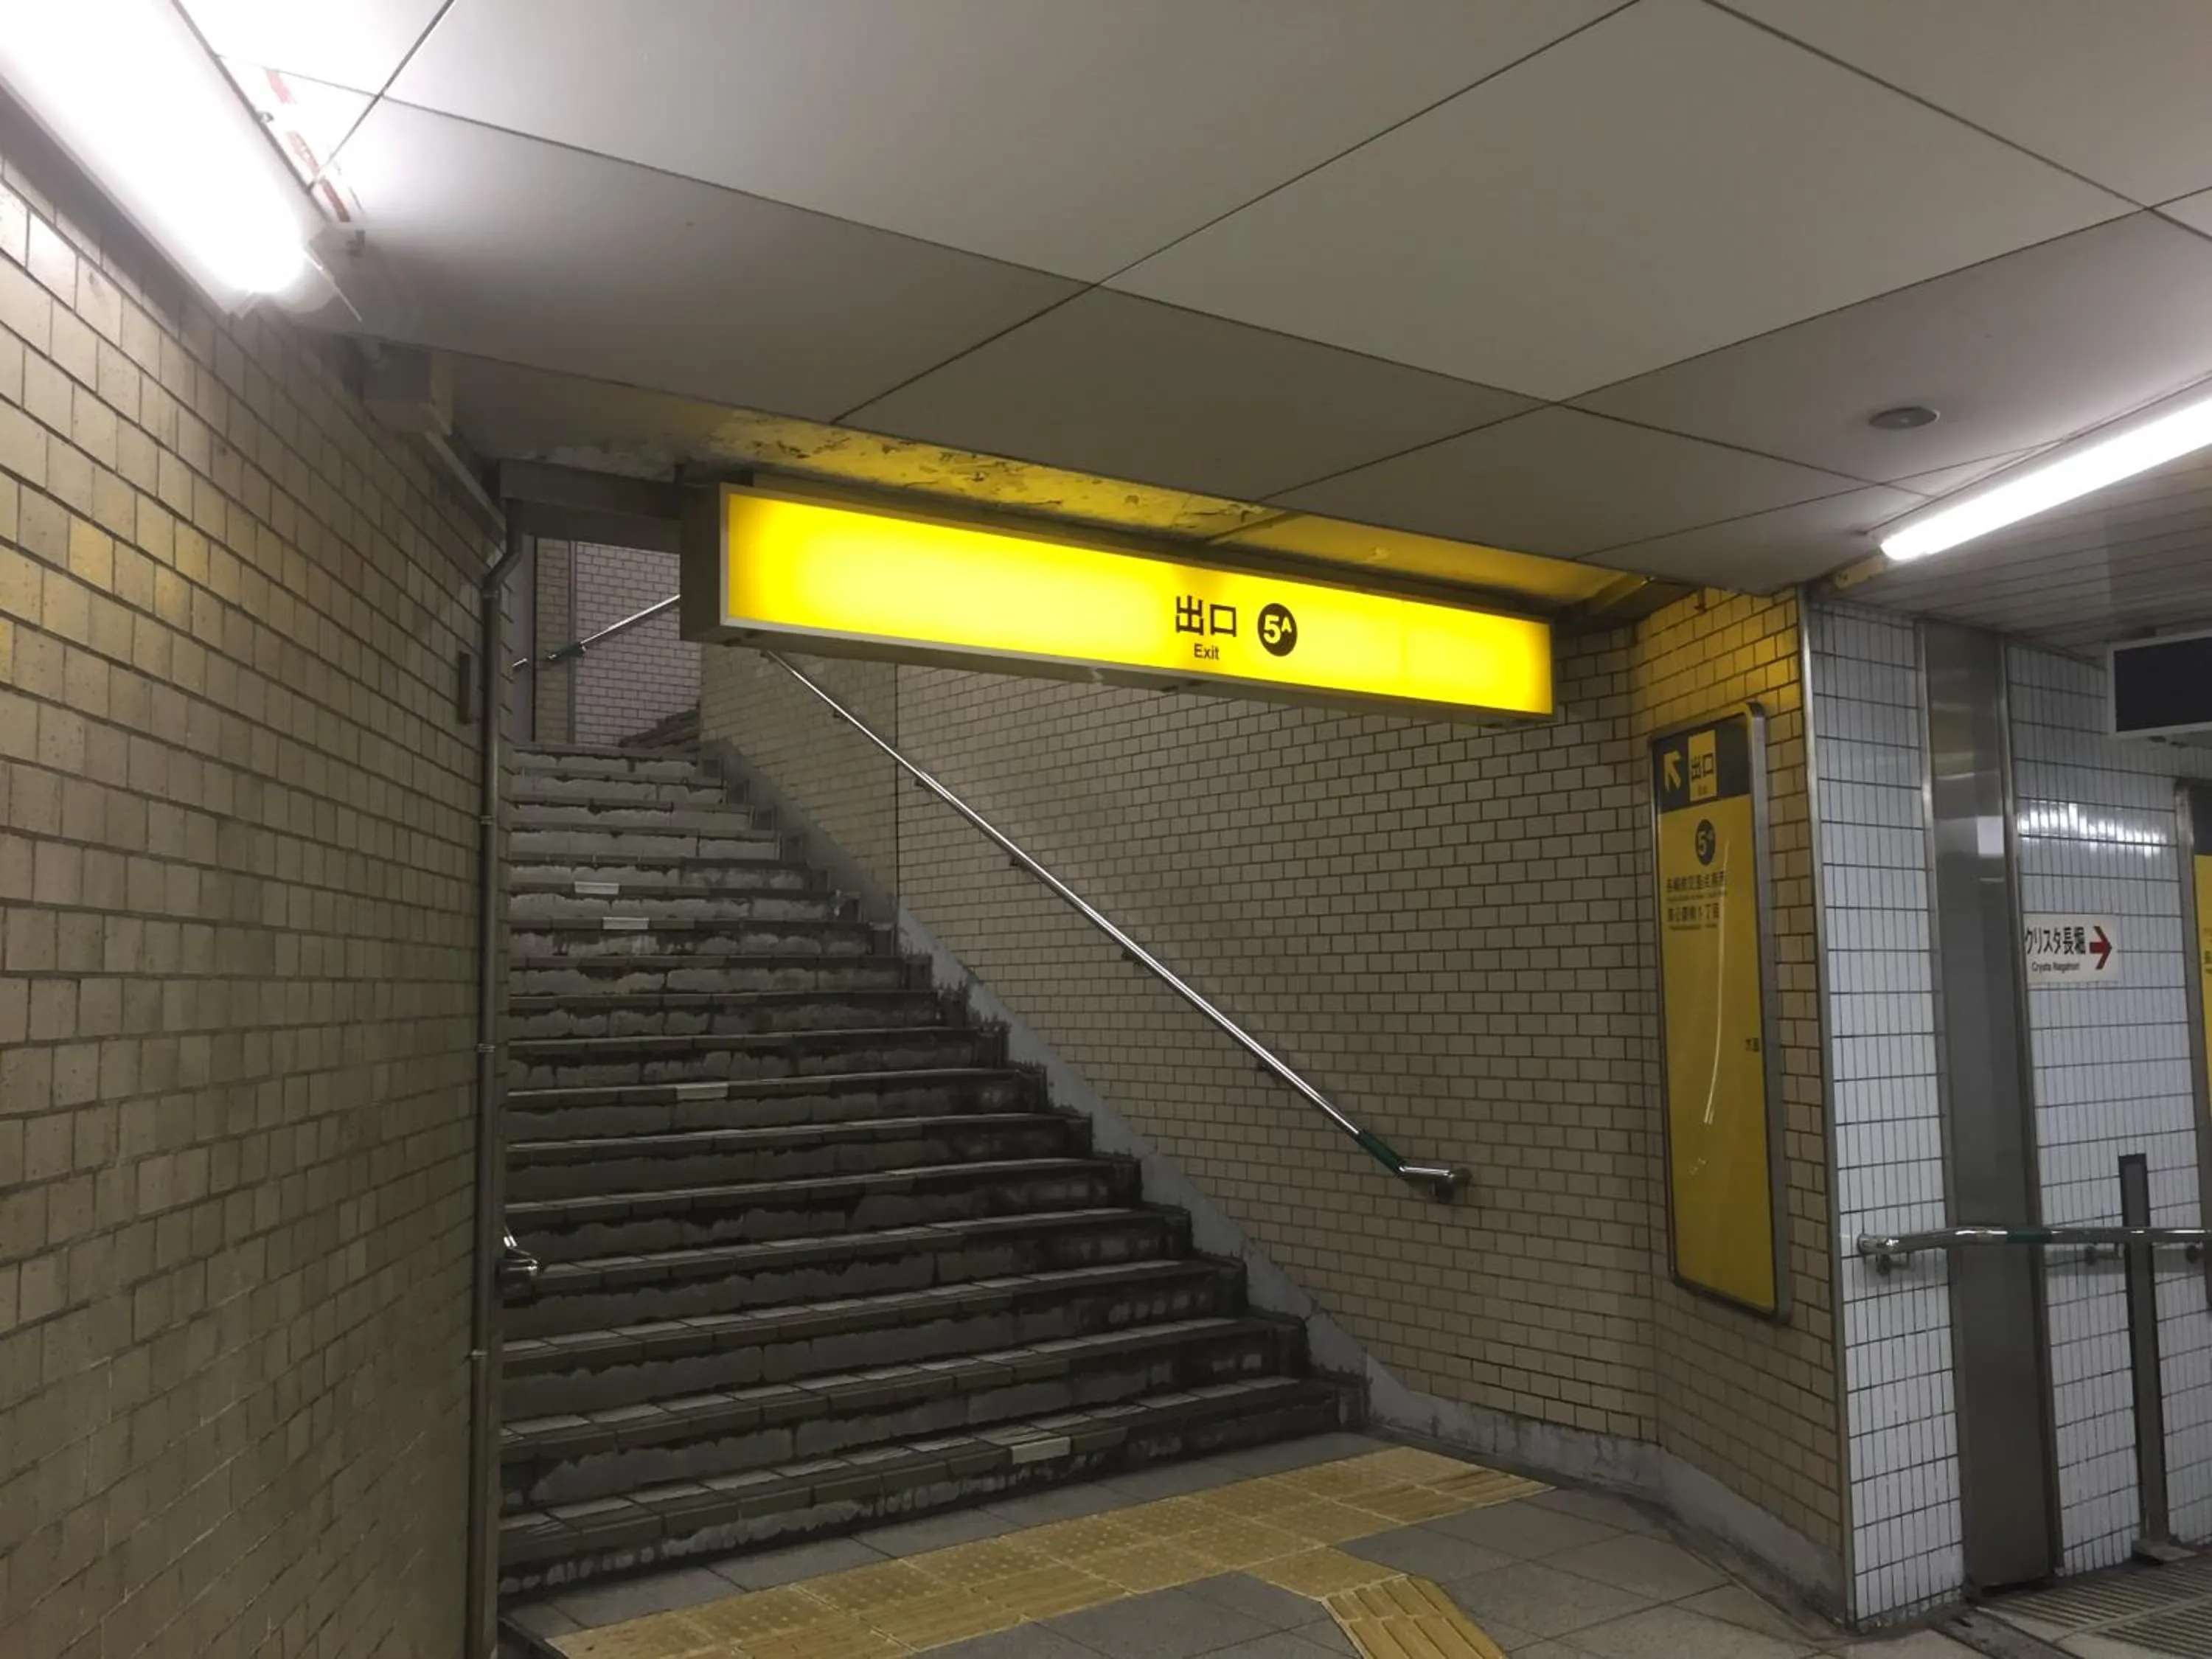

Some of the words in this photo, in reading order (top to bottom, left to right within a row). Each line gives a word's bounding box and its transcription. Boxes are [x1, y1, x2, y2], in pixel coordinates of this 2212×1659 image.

[1176, 595, 1237, 637] 出口
[1264, 615, 1292, 644] 5A
[1194, 643, 1220, 661] Exit
[1691, 753, 1714, 780] 出口
[2025, 926, 2086, 955] クリスタ長堀
